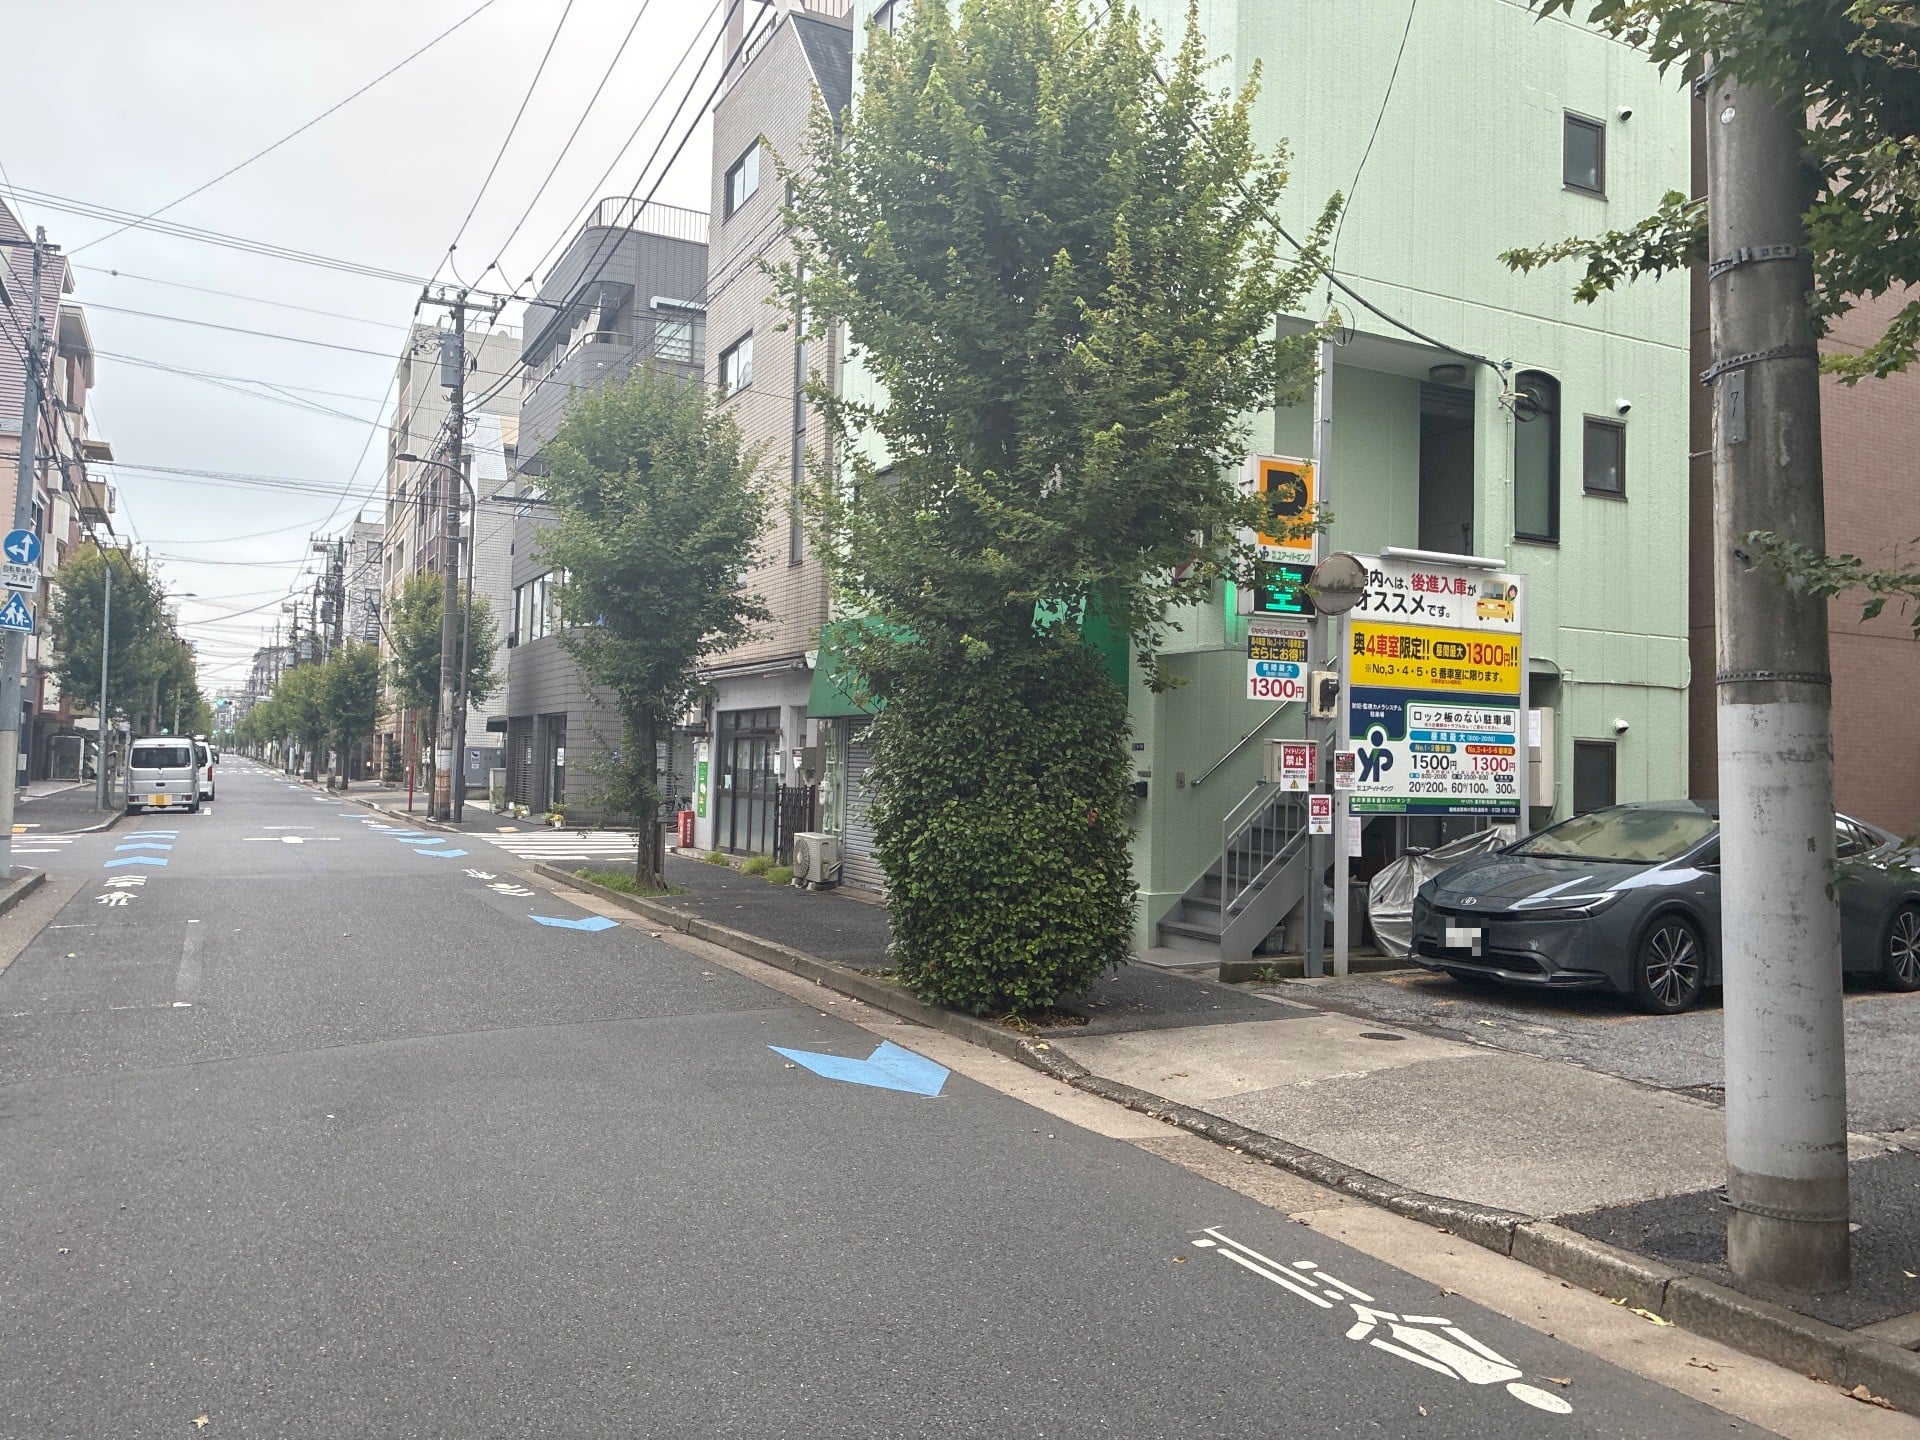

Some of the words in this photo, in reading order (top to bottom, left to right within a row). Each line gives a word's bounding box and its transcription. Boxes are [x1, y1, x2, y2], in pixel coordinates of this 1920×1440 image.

[1267, 470, 1308, 518] P
[1435, 644, 1464, 659] 昼間最大
[1250, 678, 1305, 698] 1300円
[1413, 711, 1512, 727] ロック板のない駐車場
[1285, 755, 1304, 766] 禁止
[1411, 754, 1457, 771] 1500円
[1472, 756, 1516, 772] 1300円
[1312, 805, 1328, 814] 禁止
